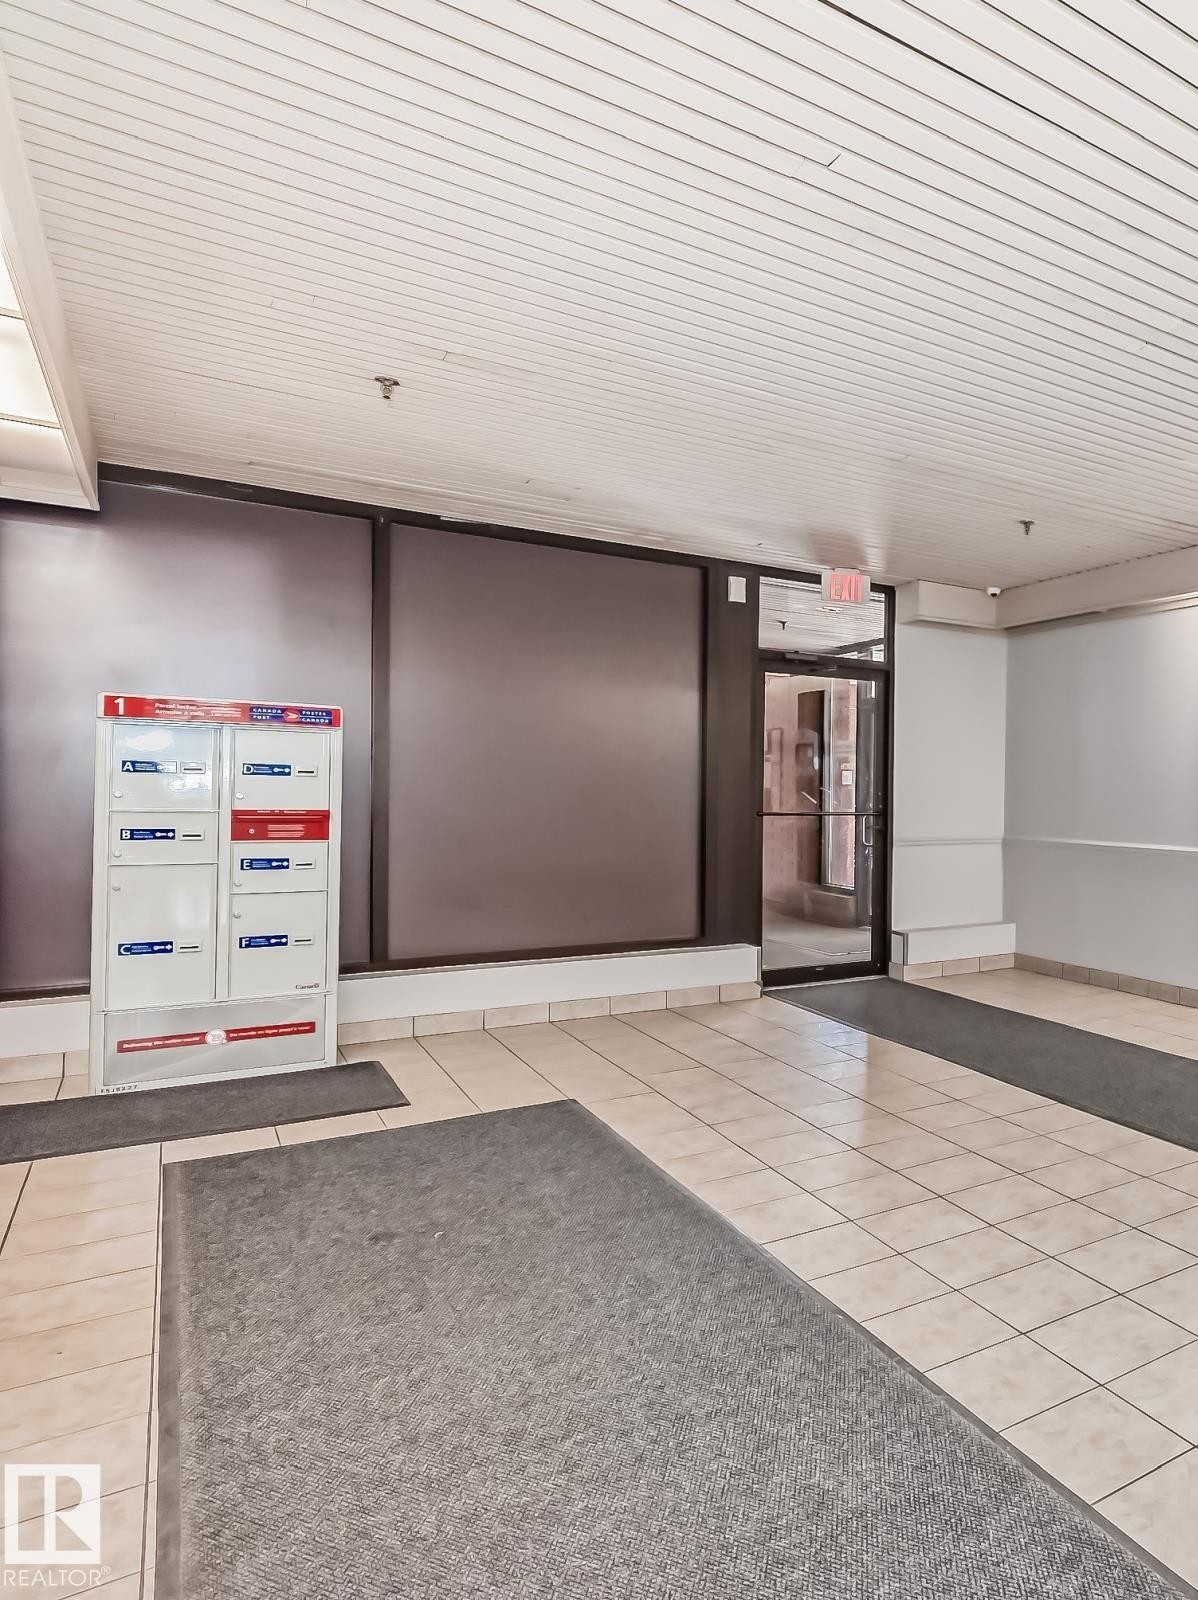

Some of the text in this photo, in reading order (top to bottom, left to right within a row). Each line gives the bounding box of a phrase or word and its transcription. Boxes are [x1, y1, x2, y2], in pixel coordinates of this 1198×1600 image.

[830, 573, 864, 602] EXIT
[114, 697, 126, 715] 1
[122, 761, 134, 772] A
[243, 764, 254, 774] D
[122, 829, 131, 839] B
[243, 860, 251, 870] E
[241, 938, 250, 948] F
[120, 945, 131, 955] C
